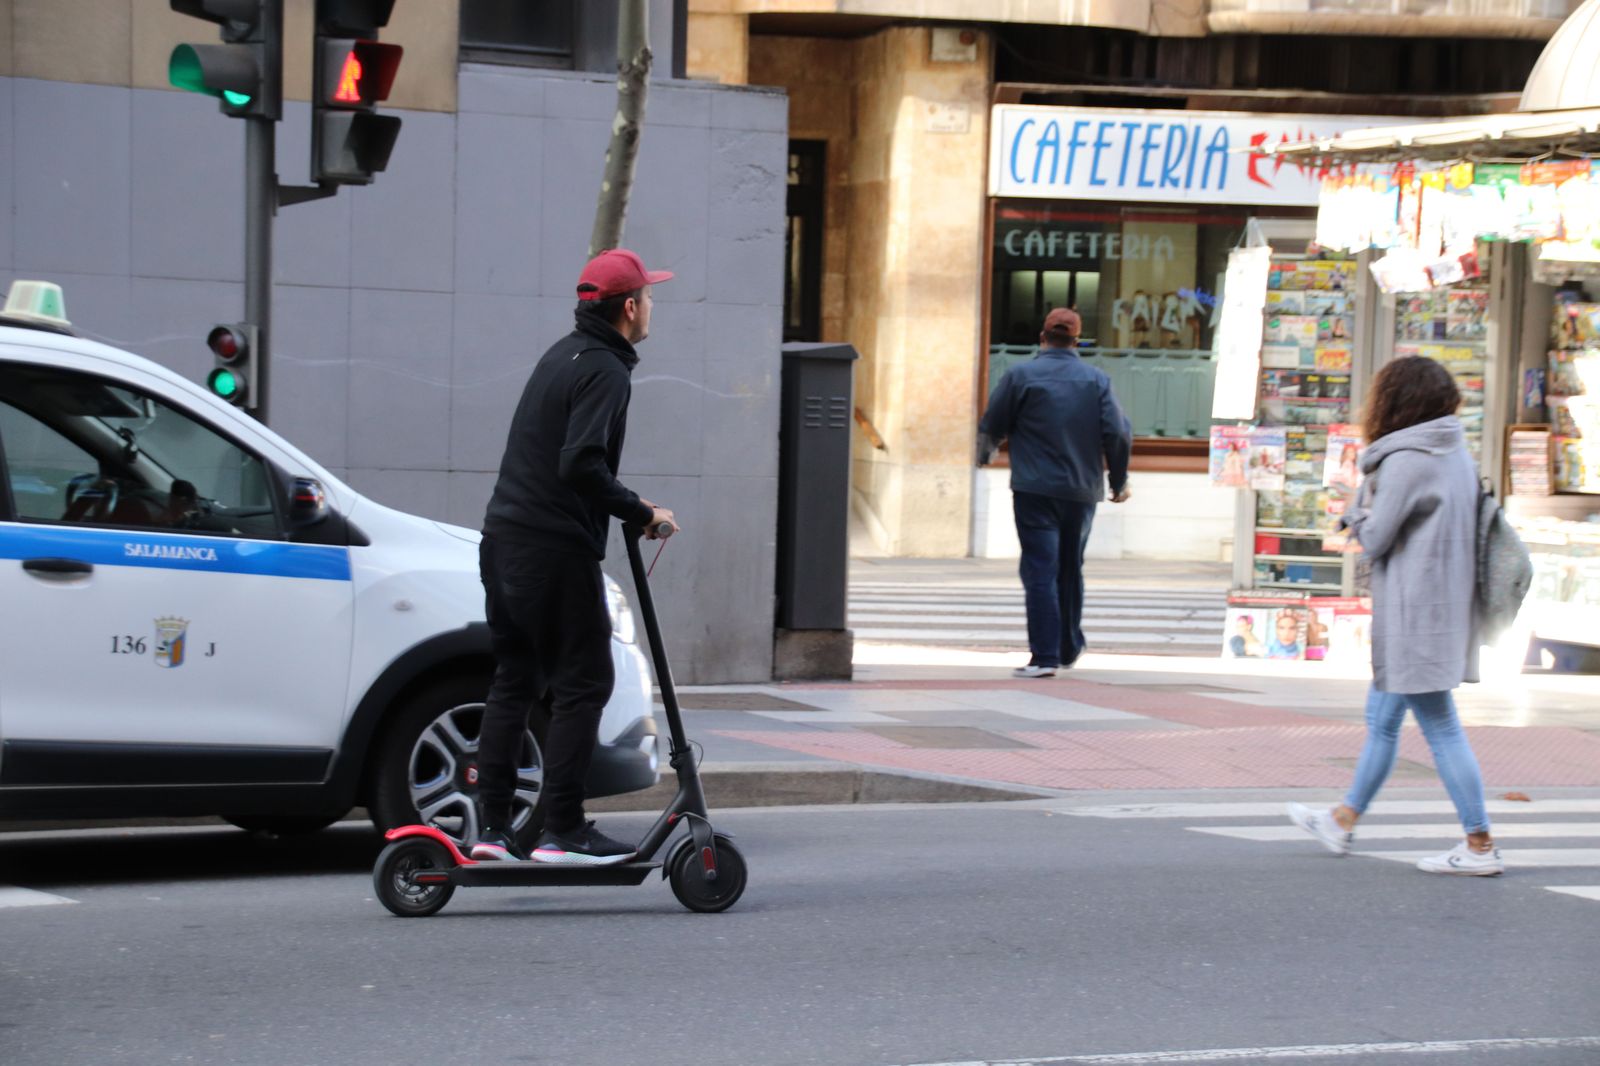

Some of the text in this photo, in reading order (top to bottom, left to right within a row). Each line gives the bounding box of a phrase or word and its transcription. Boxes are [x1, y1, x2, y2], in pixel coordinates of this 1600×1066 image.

[1009, 117, 1230, 191] CAFETERIA
[1004, 228, 1175, 261] CAFETERIA
[124, 542, 218, 561] SALAMANCA
[110, 635, 217, 657] 136 J
